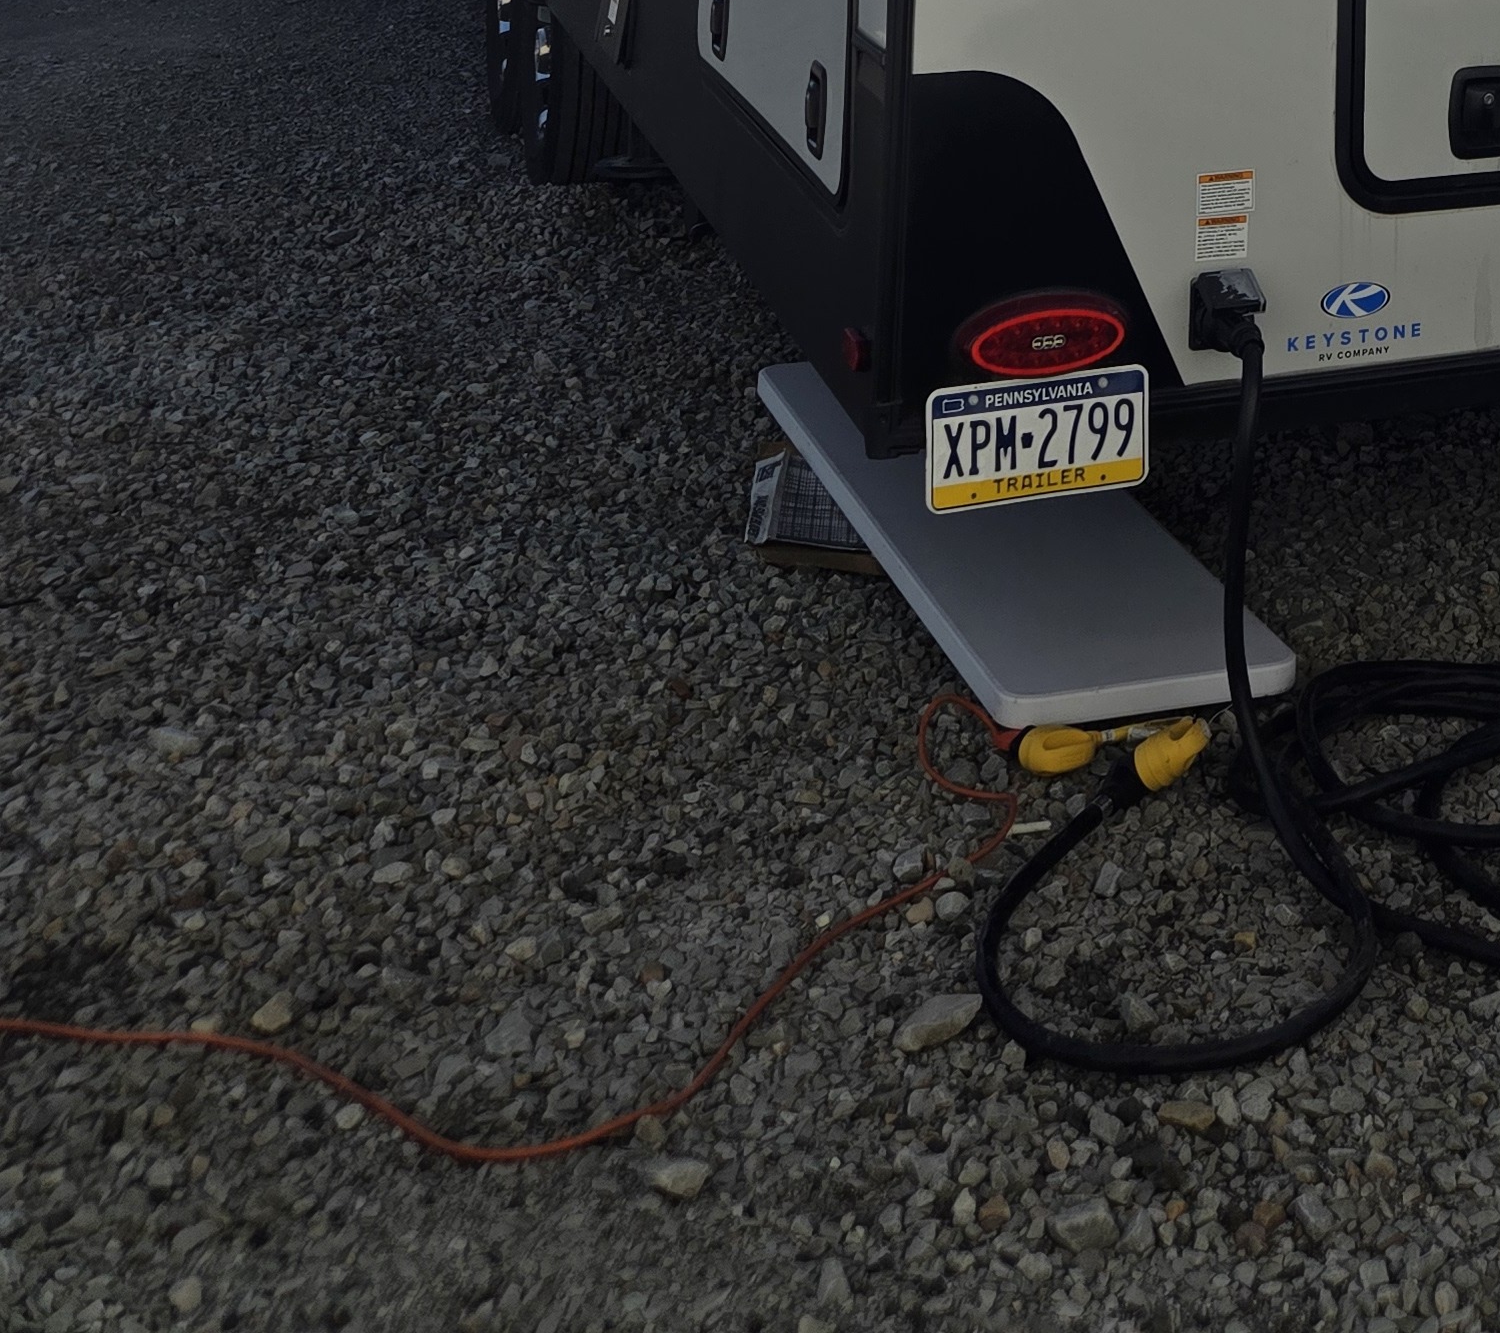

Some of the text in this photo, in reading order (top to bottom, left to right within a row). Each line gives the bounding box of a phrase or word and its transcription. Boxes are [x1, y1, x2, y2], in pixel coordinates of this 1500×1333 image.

[1287, 322, 1422, 352] KEYSTONE
[1318, 346, 1390, 362] RV COMPANY
[985, 382, 1093, 408] PENNSYLVANIA
[993, 468, 1085, 494] TRAILER
